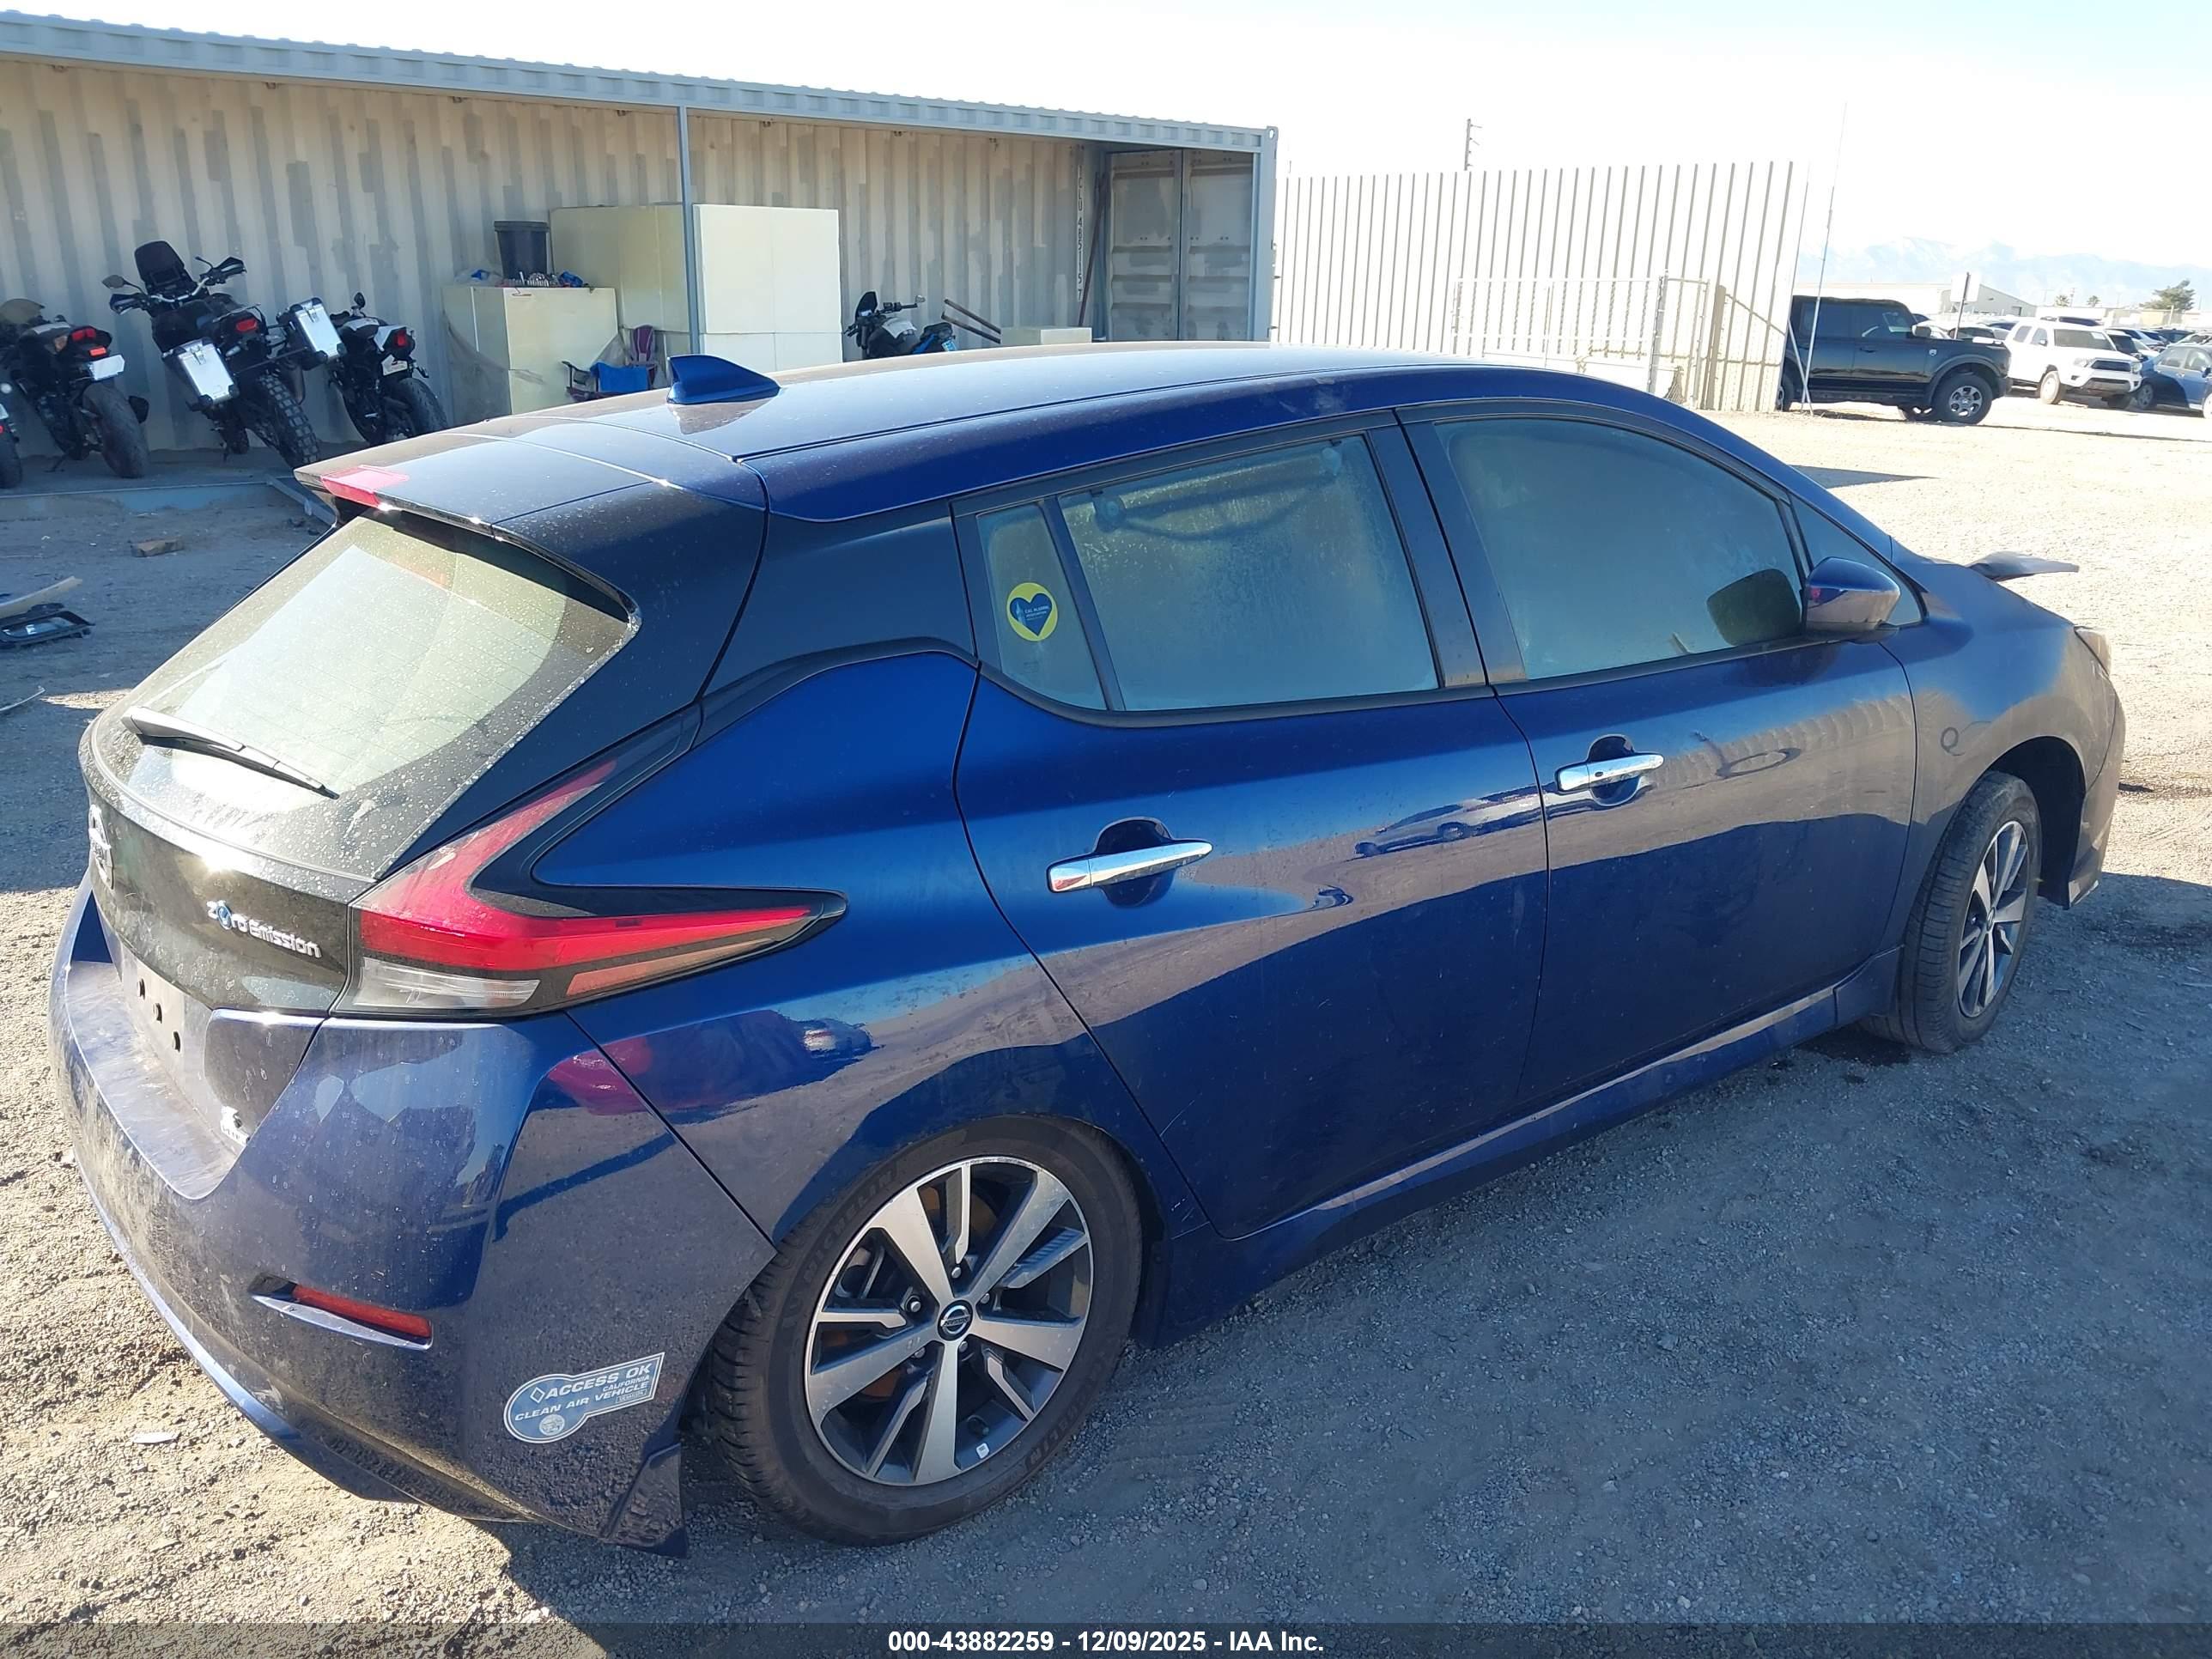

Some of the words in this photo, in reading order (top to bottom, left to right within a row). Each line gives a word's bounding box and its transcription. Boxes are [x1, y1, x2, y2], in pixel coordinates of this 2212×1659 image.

[248, 918, 323, 958] Emission
[544, 1372, 619, 1400] ACCESS
[625, 1363, 653, 1379] OK
[602, 1375, 650, 1392] CALIFORNIA
[514, 1404, 562, 1421] CLEAN
[566, 1397, 589, 1410] AIR
[594, 1381, 650, 1402] VEHICLE
